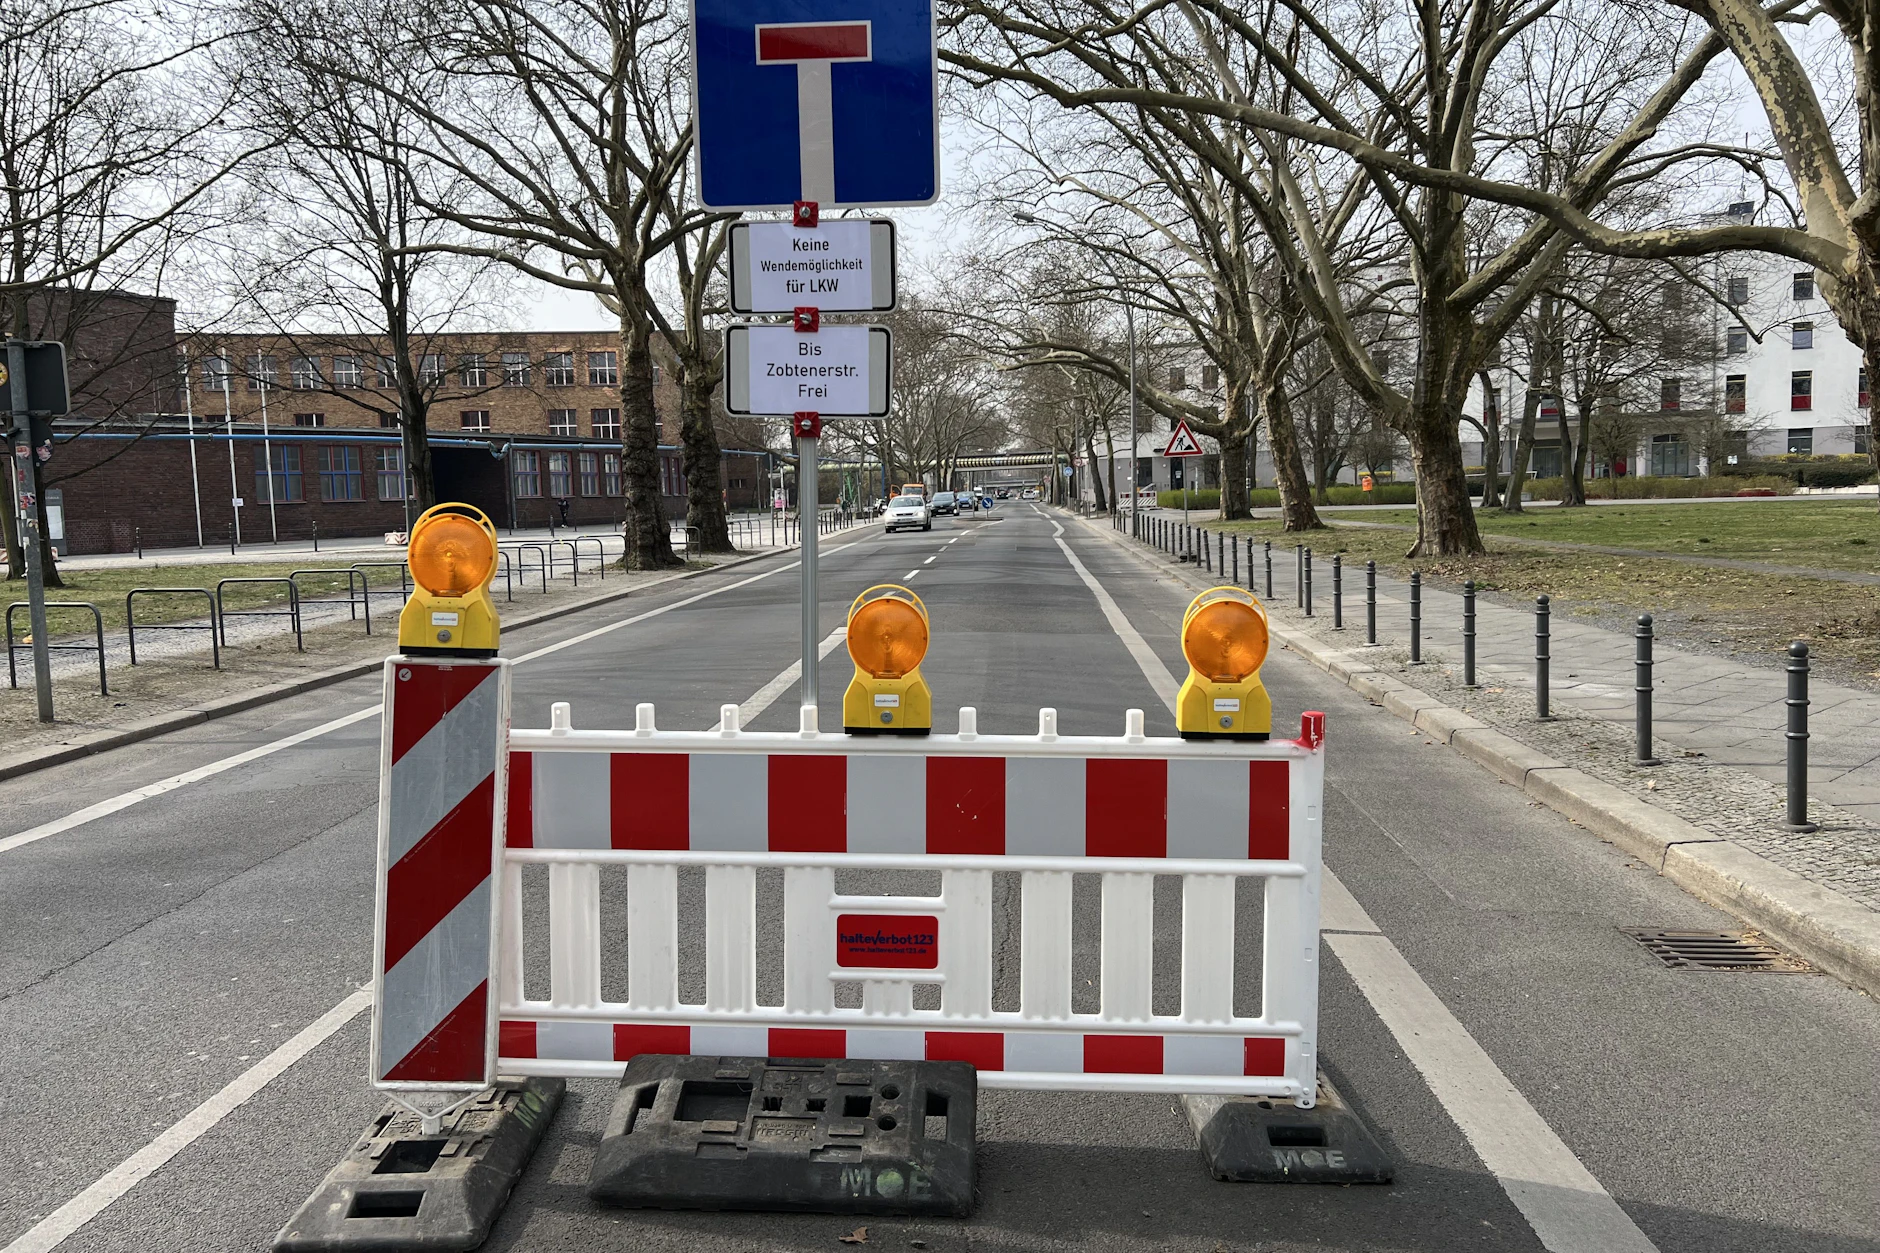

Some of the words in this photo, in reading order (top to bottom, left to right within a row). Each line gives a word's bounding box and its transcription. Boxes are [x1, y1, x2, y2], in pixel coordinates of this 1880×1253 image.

[792, 238, 830, 251] Keine
[760, 258, 863, 273] Wendemöglichkeit
[786, 279, 806, 293] für
[810, 278, 839, 293] LKW
[798, 342, 822, 356] Bis
[766, 363, 859, 377] Zobtenerstr.
[798, 384, 828, 397] Frei
[848, 946, 927, 954] www.halteverbot123.de
